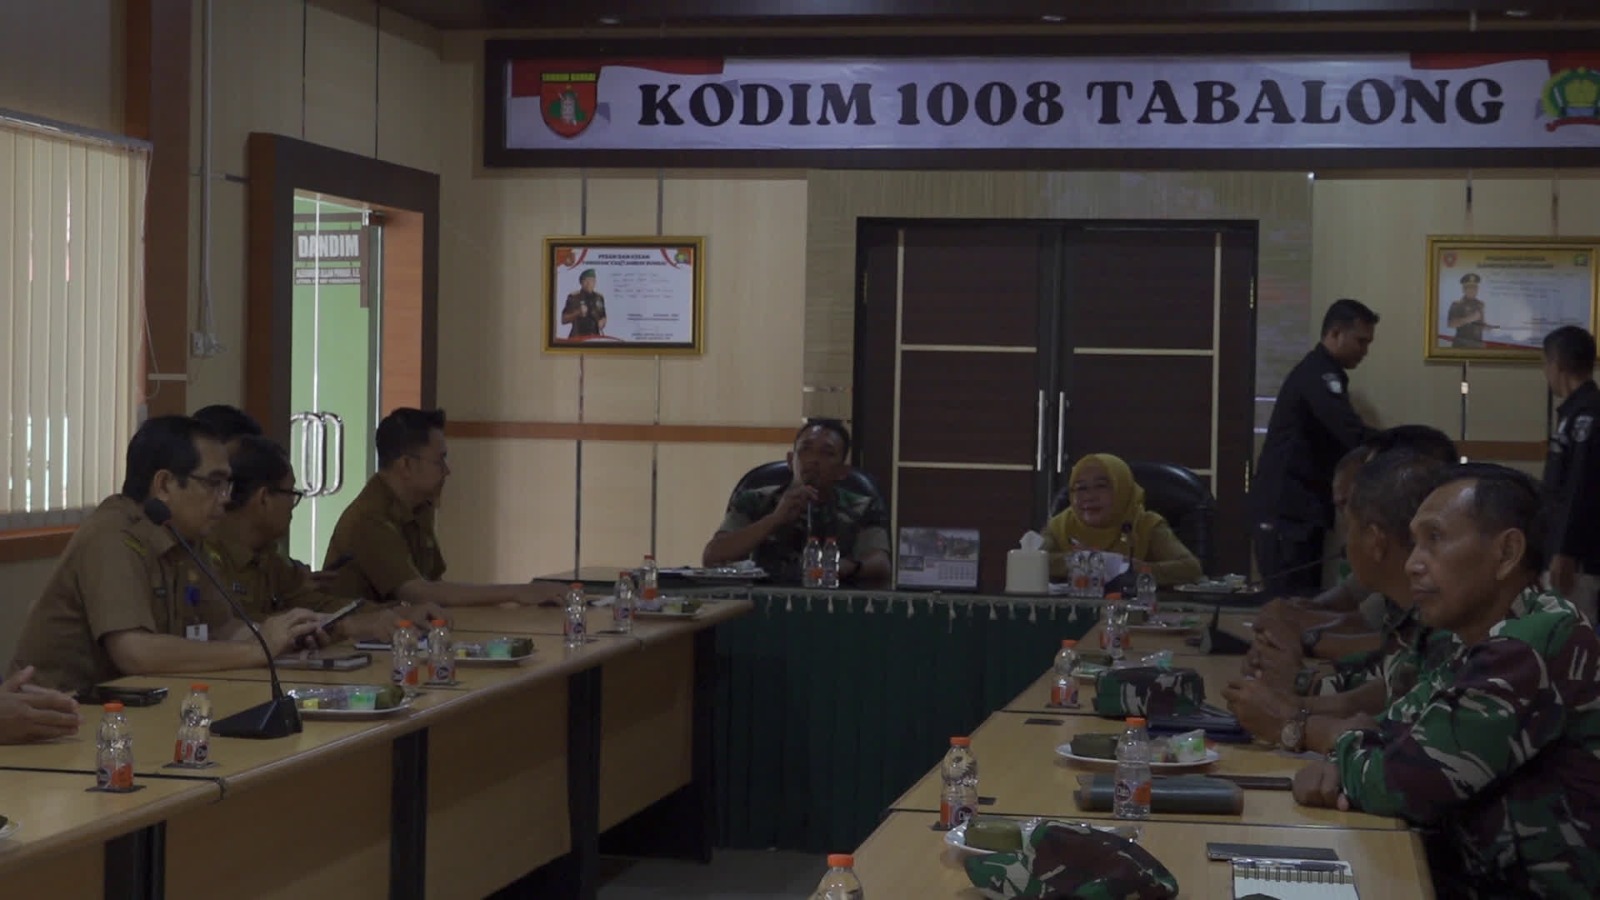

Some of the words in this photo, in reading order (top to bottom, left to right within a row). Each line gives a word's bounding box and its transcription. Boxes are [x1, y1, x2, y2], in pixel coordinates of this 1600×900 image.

[637, 82, 876, 127] KODIM
[897, 81, 1065, 126] 1008
[1086, 78, 1505, 125] TABALONG
[298, 234, 359, 258] DANDIM
